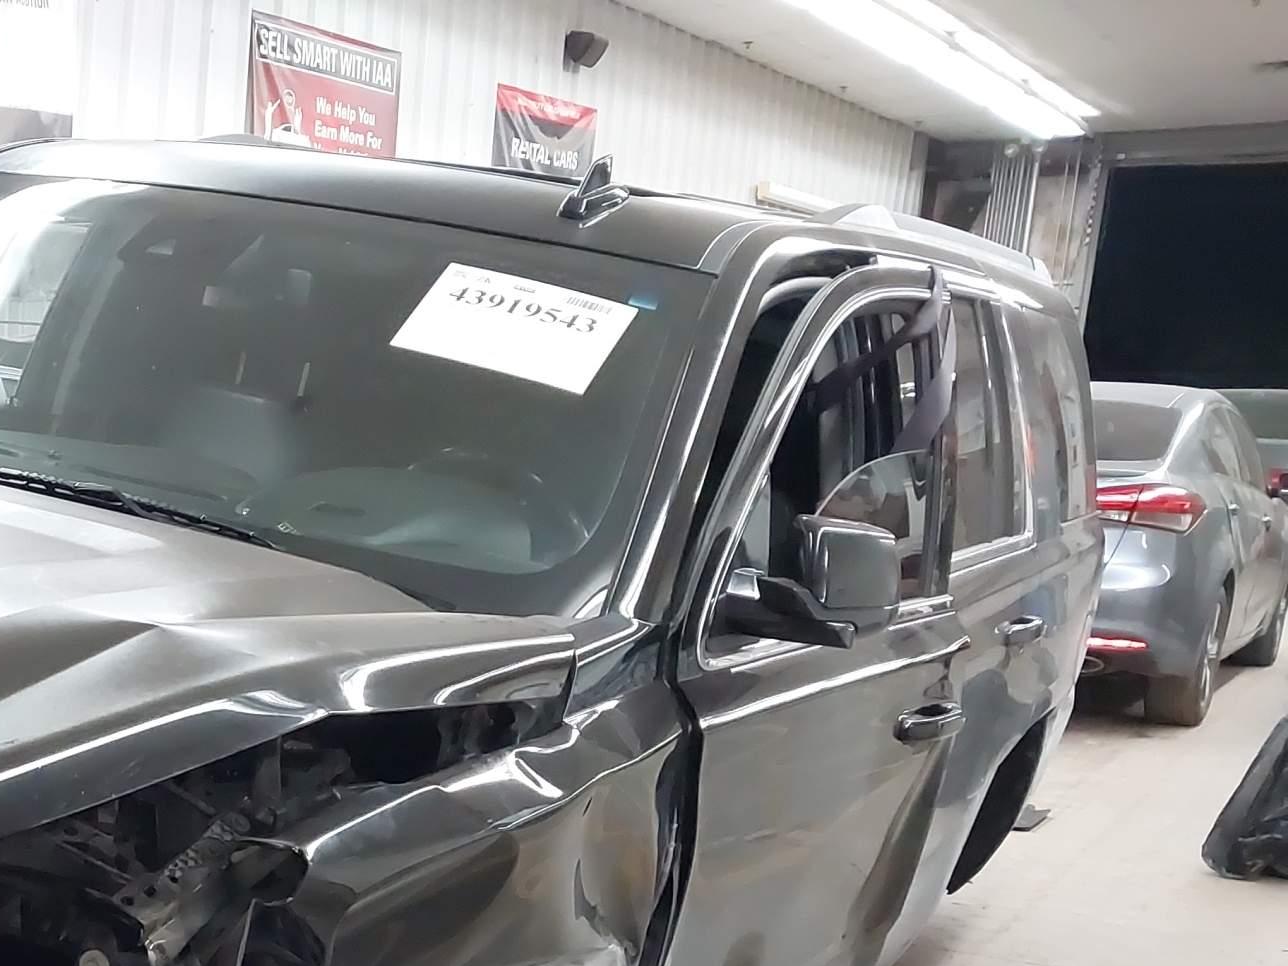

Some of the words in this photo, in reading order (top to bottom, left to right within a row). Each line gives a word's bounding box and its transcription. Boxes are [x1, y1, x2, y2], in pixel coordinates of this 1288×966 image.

[259, 28, 290, 61] SELL
[293, 37, 337, 73] SMART
[339, 49, 371, 82] WITH
[372, 60, 392, 87] IAA
[316, 96, 332, 116] We
[334, 101, 356, 124] Help
[358, 105, 376, 126] You
[314, 119, 337, 140] Earn
[339, 125, 364, 146] More
[366, 131, 383, 150] For
[553, 150, 579, 170] CARS
[449, 287, 597, 333] 43919543
